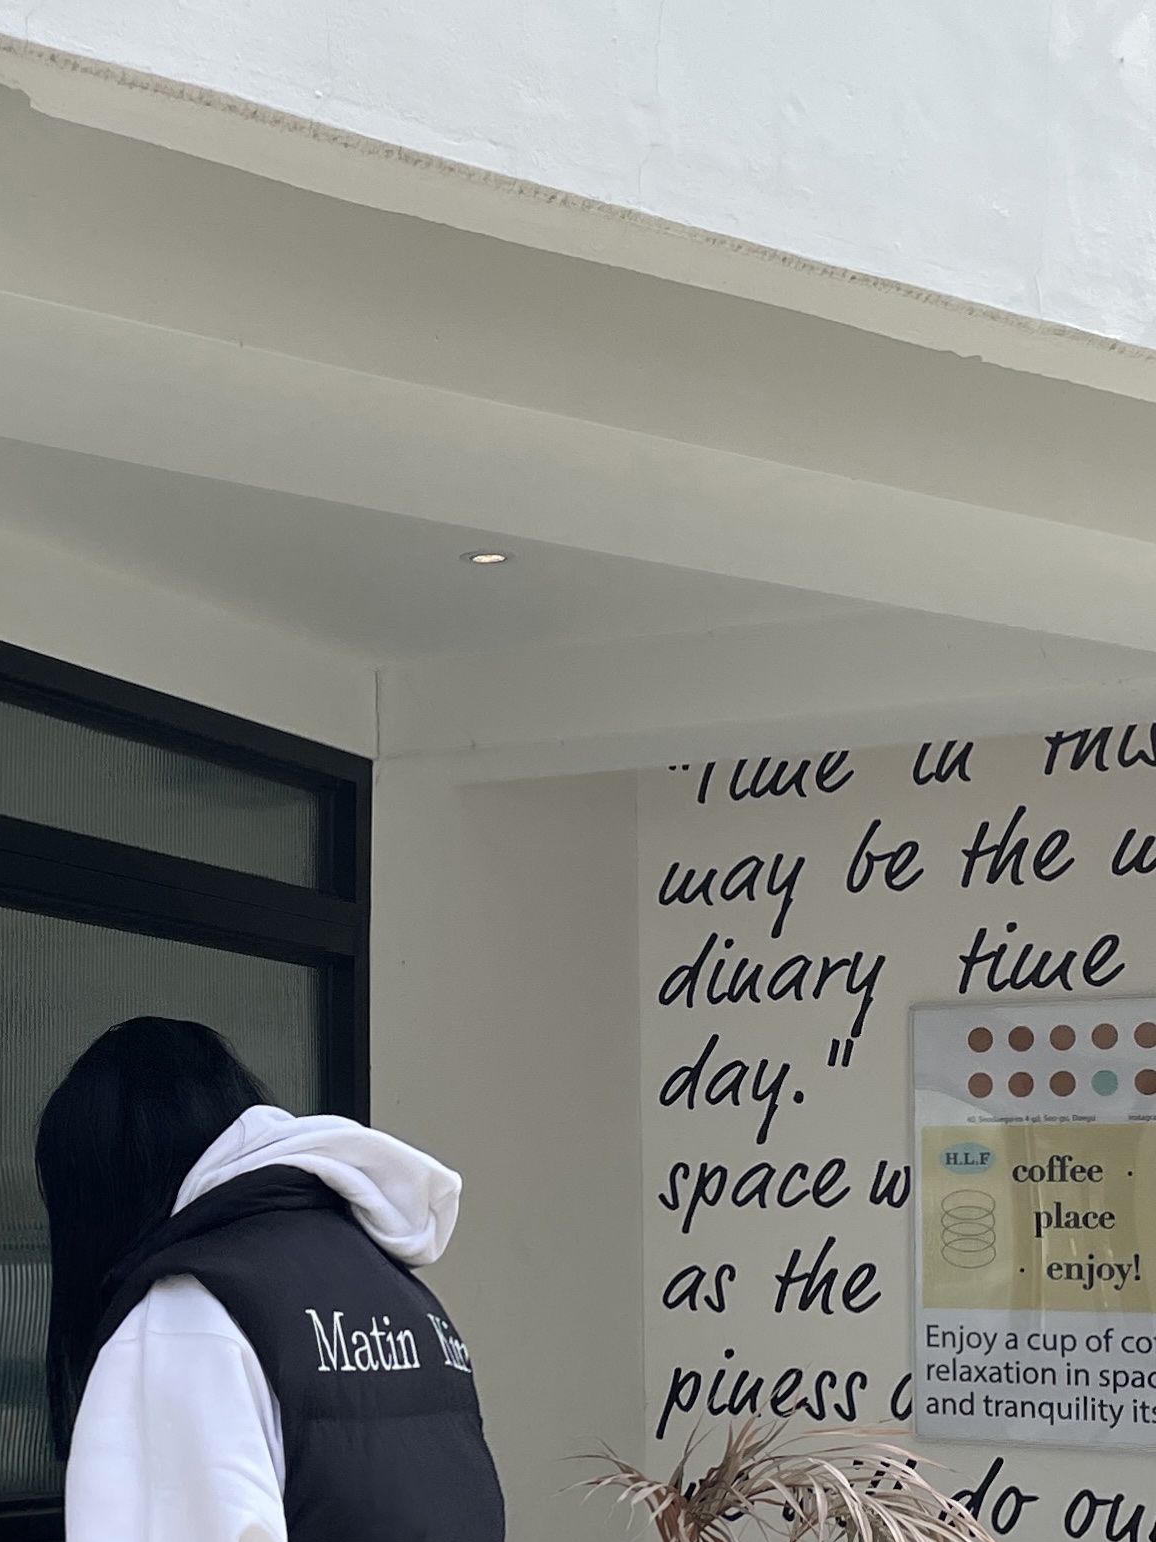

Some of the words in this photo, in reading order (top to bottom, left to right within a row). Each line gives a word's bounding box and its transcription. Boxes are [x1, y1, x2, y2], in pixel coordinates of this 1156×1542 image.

[658, 853, 806, 938] may
[846, 818, 925, 894] be
[961, 805, 1075, 888] the
[658, 932, 886, 1039] dinary
[958, 921, 1125, 995] time
[659, 1033, 854, 1145] day."
[944, 1150, 991, 1167] H.L.F
[1012, 1154, 1104, 1183] coffee
[658, 1158, 851, 1239] space
[1034, 1201, 1116, 1239] place
[662, 1263, 736, 1313] as
[774, 1236, 882, 1315] the
[1046, 1253, 1141, 1291] enjoy!
[305, 1308, 421, 1372] Matin
[926, 1324, 998, 1356] Enjoy
[1005, 1332, 1019, 1350] a
[1027, 1333, 1077, 1358] cup
[1085, 1327, 1115, 1353] of
[655, 1348, 868, 1443] piness
[925, 1357, 1057, 1386] relaxation
[1066, 1362, 1090, 1387] in
[926, 1391, 975, 1416] and
[982, 1391, 1125, 1429] tranquility
